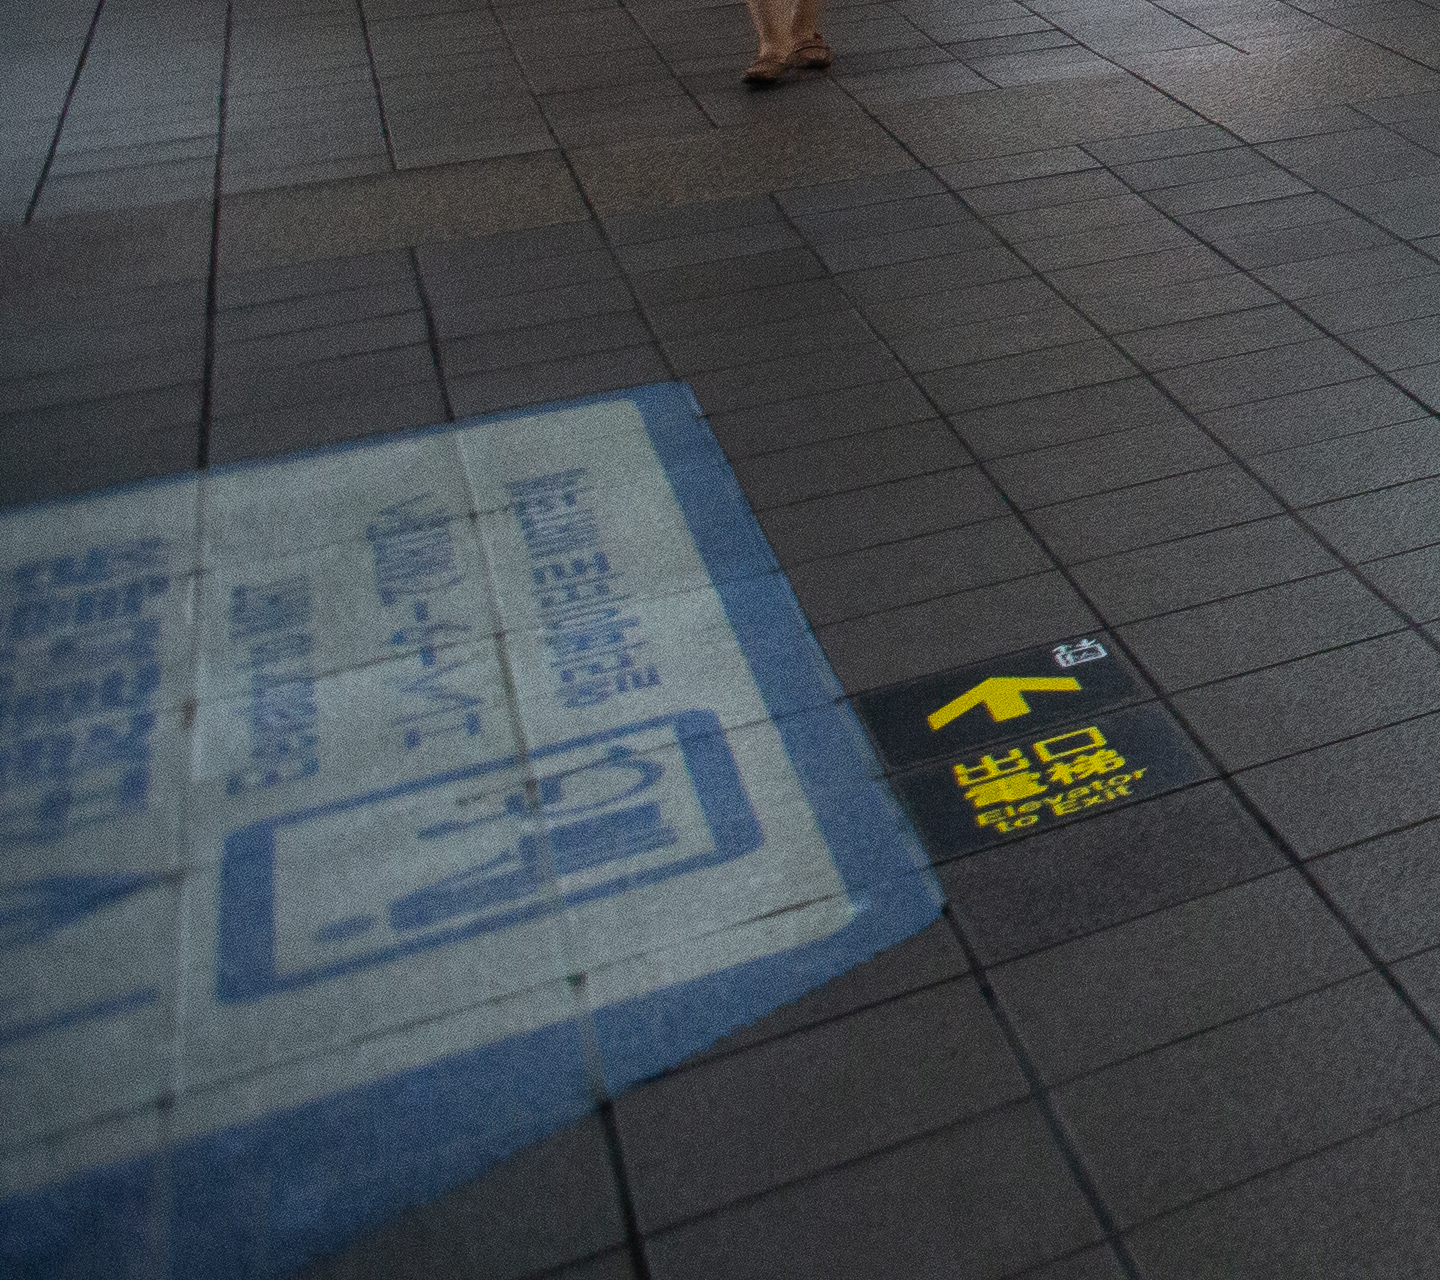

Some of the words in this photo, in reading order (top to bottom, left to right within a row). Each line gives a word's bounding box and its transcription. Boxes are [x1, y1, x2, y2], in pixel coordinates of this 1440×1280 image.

[953, 726, 1107, 787] 出口
[964, 748, 1126, 808] 電梯
[975, 767, 1148, 828] Elevator
[996, 813, 1039, 833] to
[1051, 785, 1133, 817] Exit
